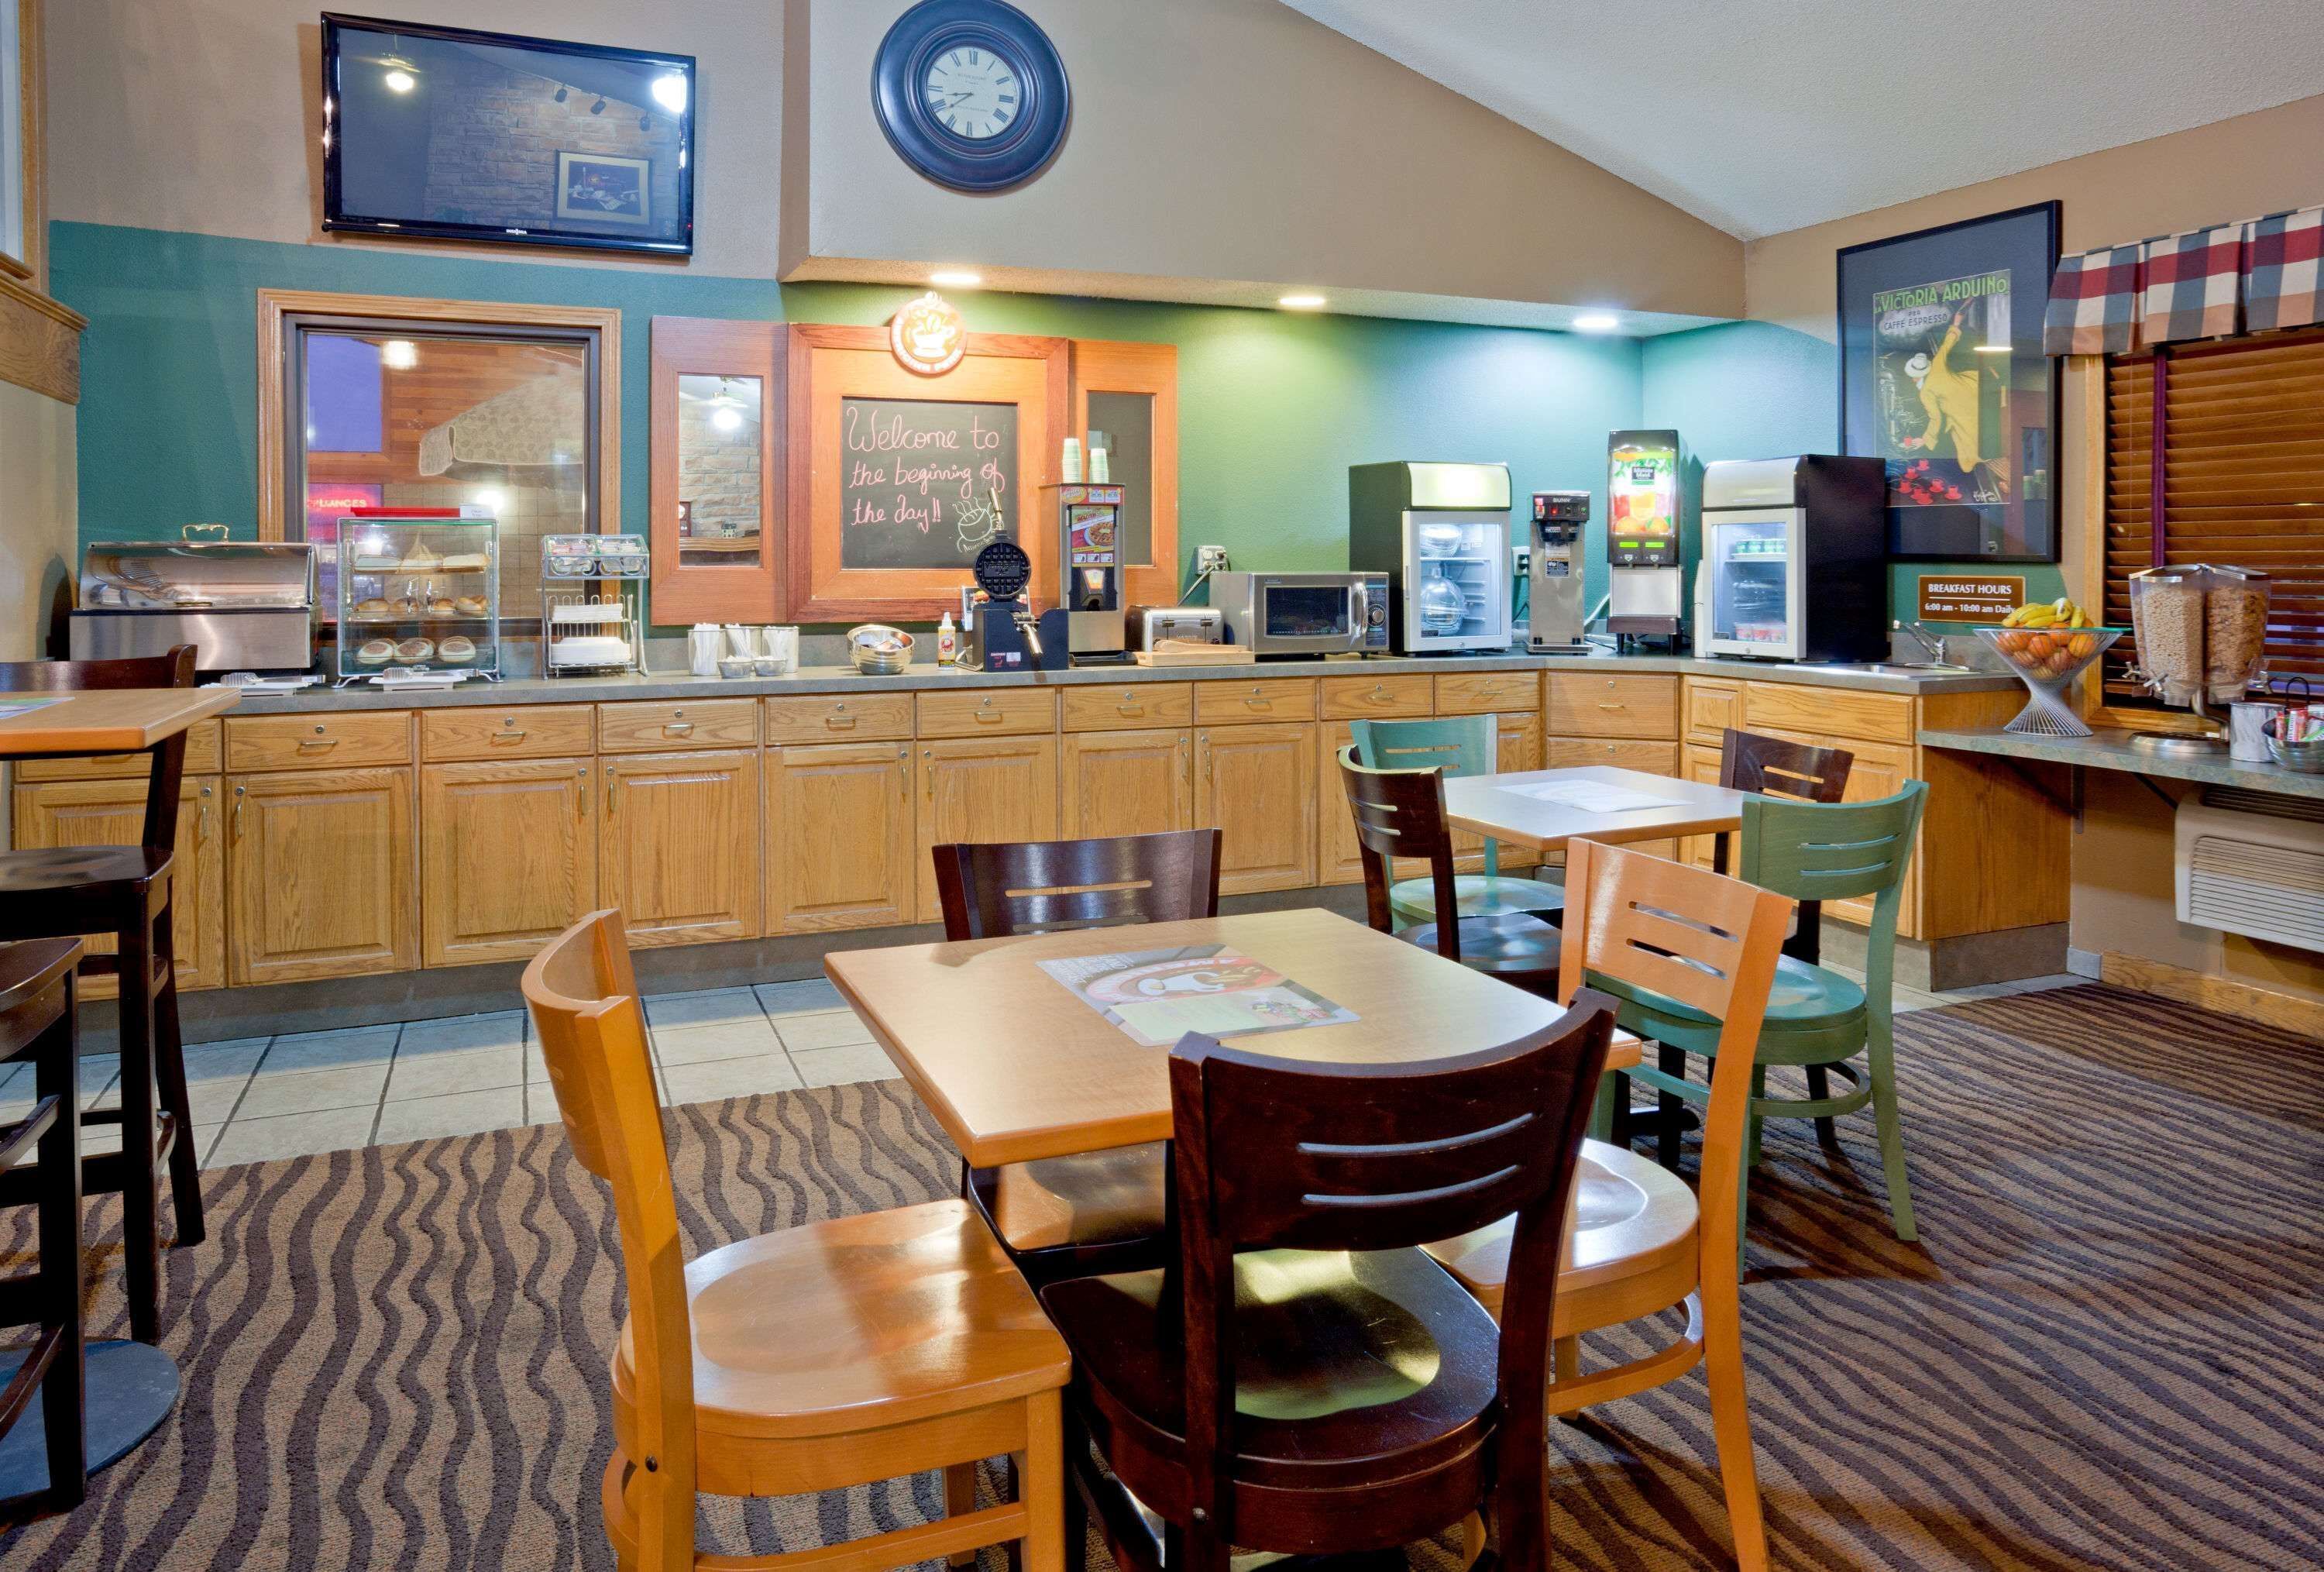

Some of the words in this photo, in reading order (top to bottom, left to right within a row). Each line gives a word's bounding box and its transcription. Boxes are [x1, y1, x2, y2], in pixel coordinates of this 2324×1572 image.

[1908, 314, 1948, 326] ESPRESSO
[847, 407, 960, 452] Welcome
[970, 415, 999, 449] to
[849, 460, 886, 488] the
[980, 457, 1005, 493] of
[851, 498, 886, 525] the
[1928, 583, 1975, 593] BREAKFAST
[1978, 584, 2012, 594] HOURS
[1960, 604, 1980, 612] 10:00
[1995, 605, 2016, 614] Daily
